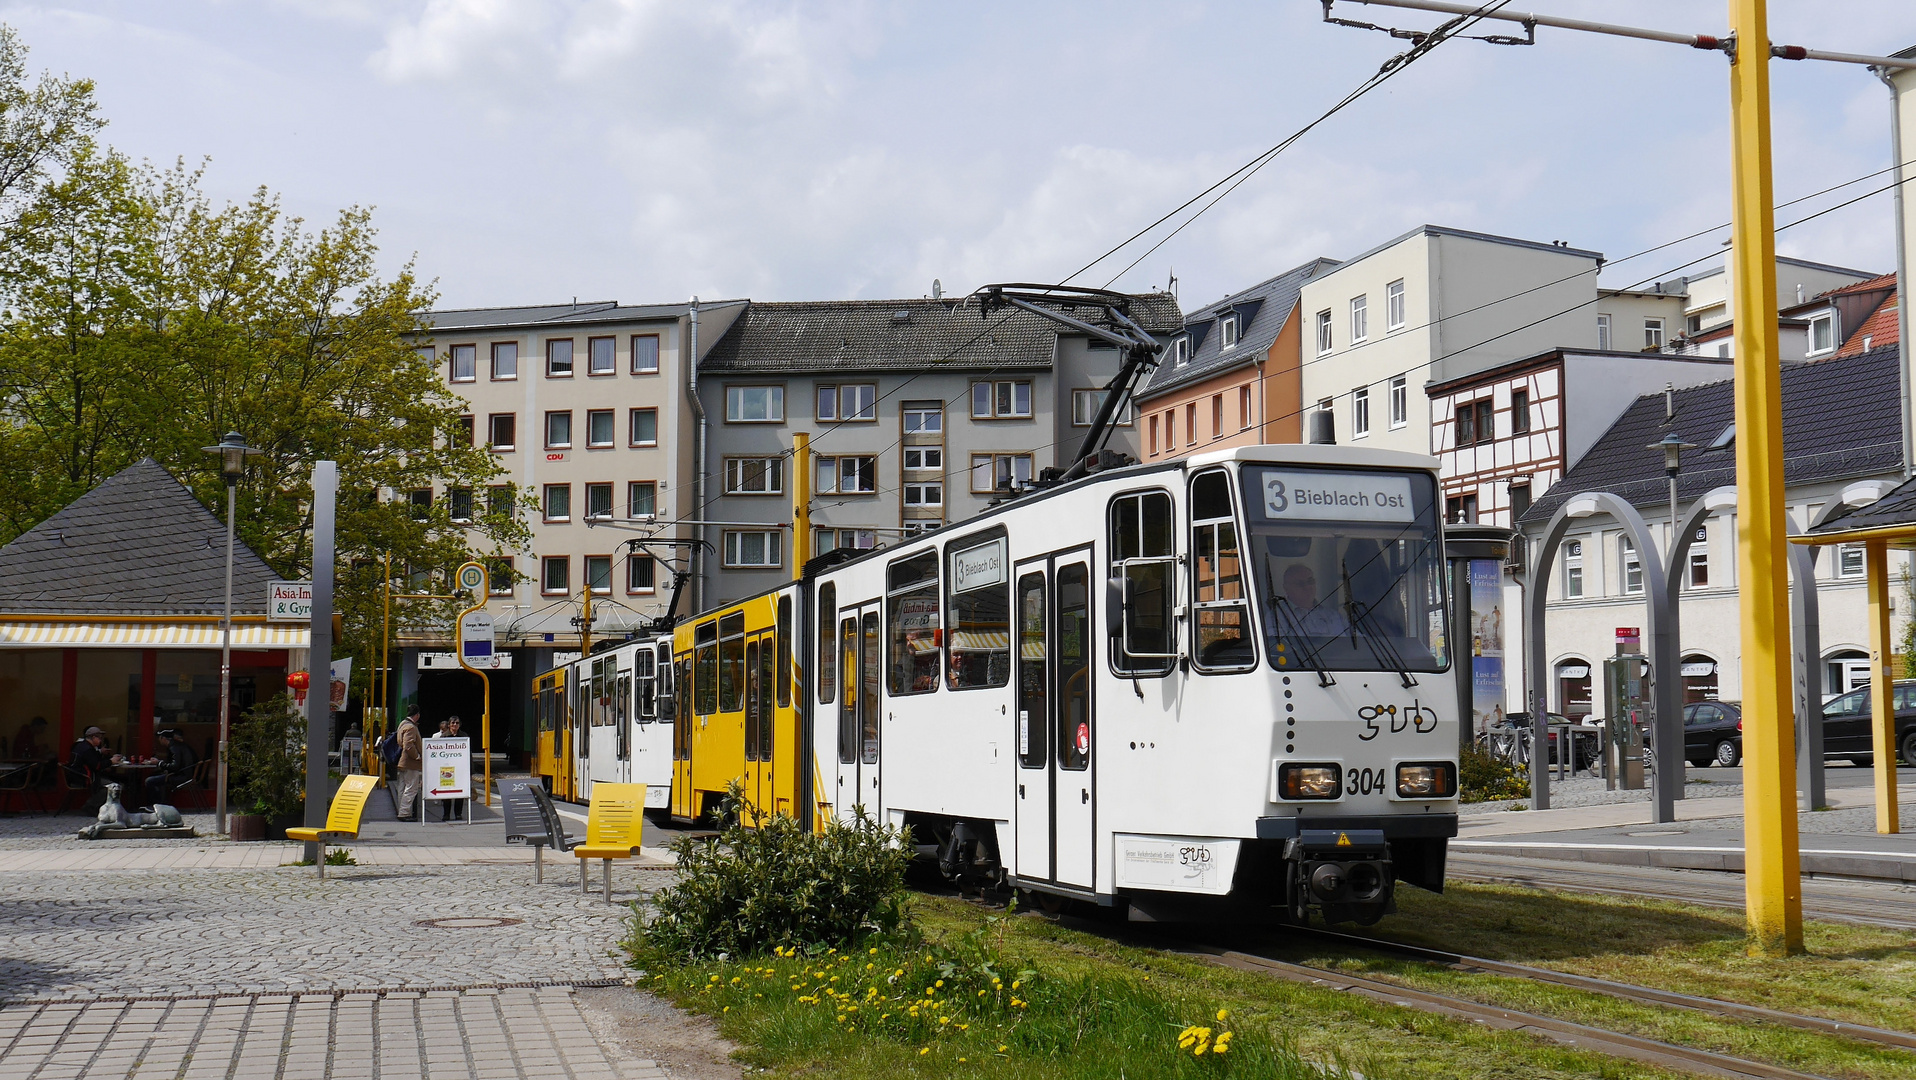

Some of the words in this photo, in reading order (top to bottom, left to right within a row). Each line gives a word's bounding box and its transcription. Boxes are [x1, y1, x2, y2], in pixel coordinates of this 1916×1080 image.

[546, 453, 564, 461] CDU
[1267, 479, 1289, 512] 3
[1294, 489, 1369, 507] Bieblach
[1374, 491, 1405, 508] Ost
[467, 572, 476, 583] H
[958, 559, 965, 585] 3
[965, 558, 988, 577] Bieblach
[988, 557, 999, 570] Ost
[273, 586, 312, 599] Asia-Im
[276, 601, 287, 614] &
[439, 751, 462, 759] Gyros
[1346, 767, 1386, 796] 304
